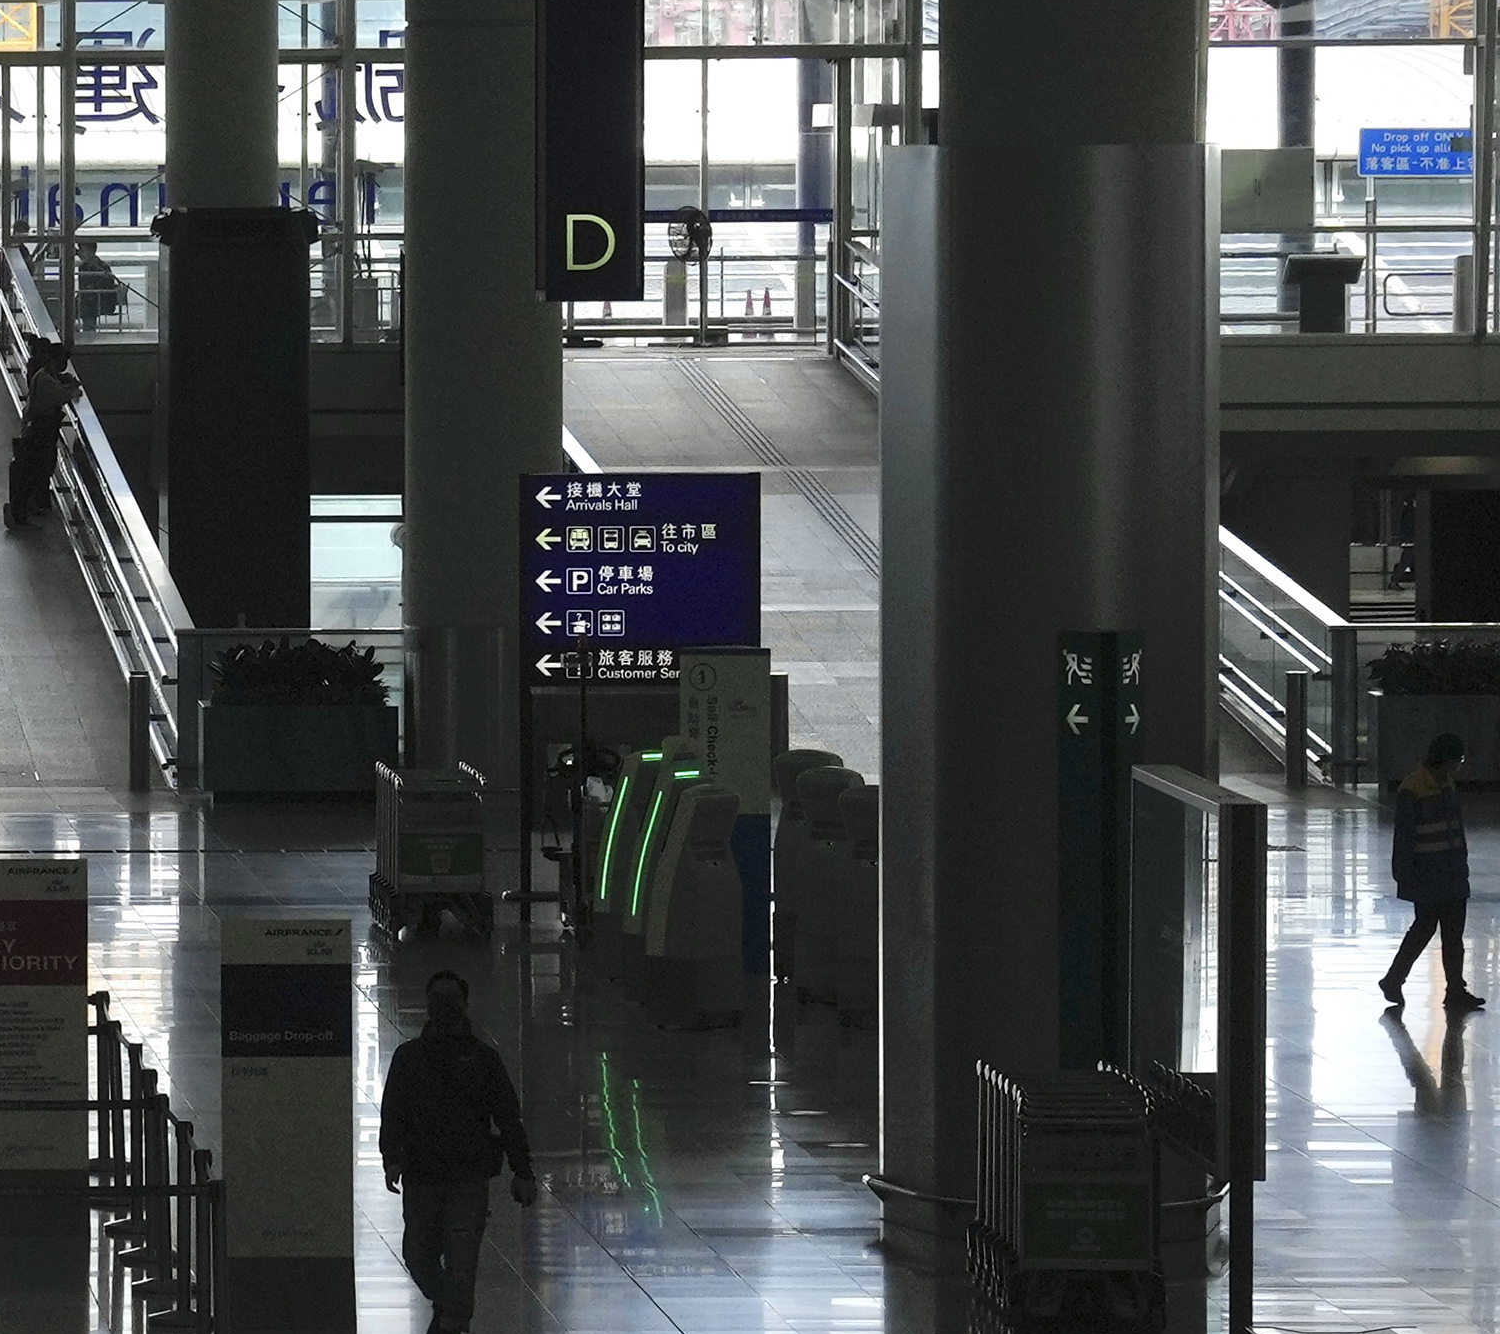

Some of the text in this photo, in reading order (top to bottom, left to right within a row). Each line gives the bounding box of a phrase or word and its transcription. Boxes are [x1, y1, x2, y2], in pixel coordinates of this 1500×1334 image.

[1384, 132, 1408, 143] Drop
[1413, 132, 1429, 142] off
[1371, 143, 1386, 153] No
[1391, 143, 1412, 154] pick
[1417, 144, 1430, 154] up
[565, 214, 616, 272] D
[566, 481, 643, 498] 接機大堂
[566, 499, 639, 511] Arrivals Hall
[661, 523, 717, 540] 往市區
[660, 541, 699, 555] To city
[598, 565, 654, 582] 停車場
[597, 583, 654, 595] Car Parks
[598, 649, 674, 667] 旅客服務
[597, 668, 656, 679] Customer
[264, 929, 333, 937] AIRFRANCE
[229, 1030, 334, 1043] Baggage Drop-off
